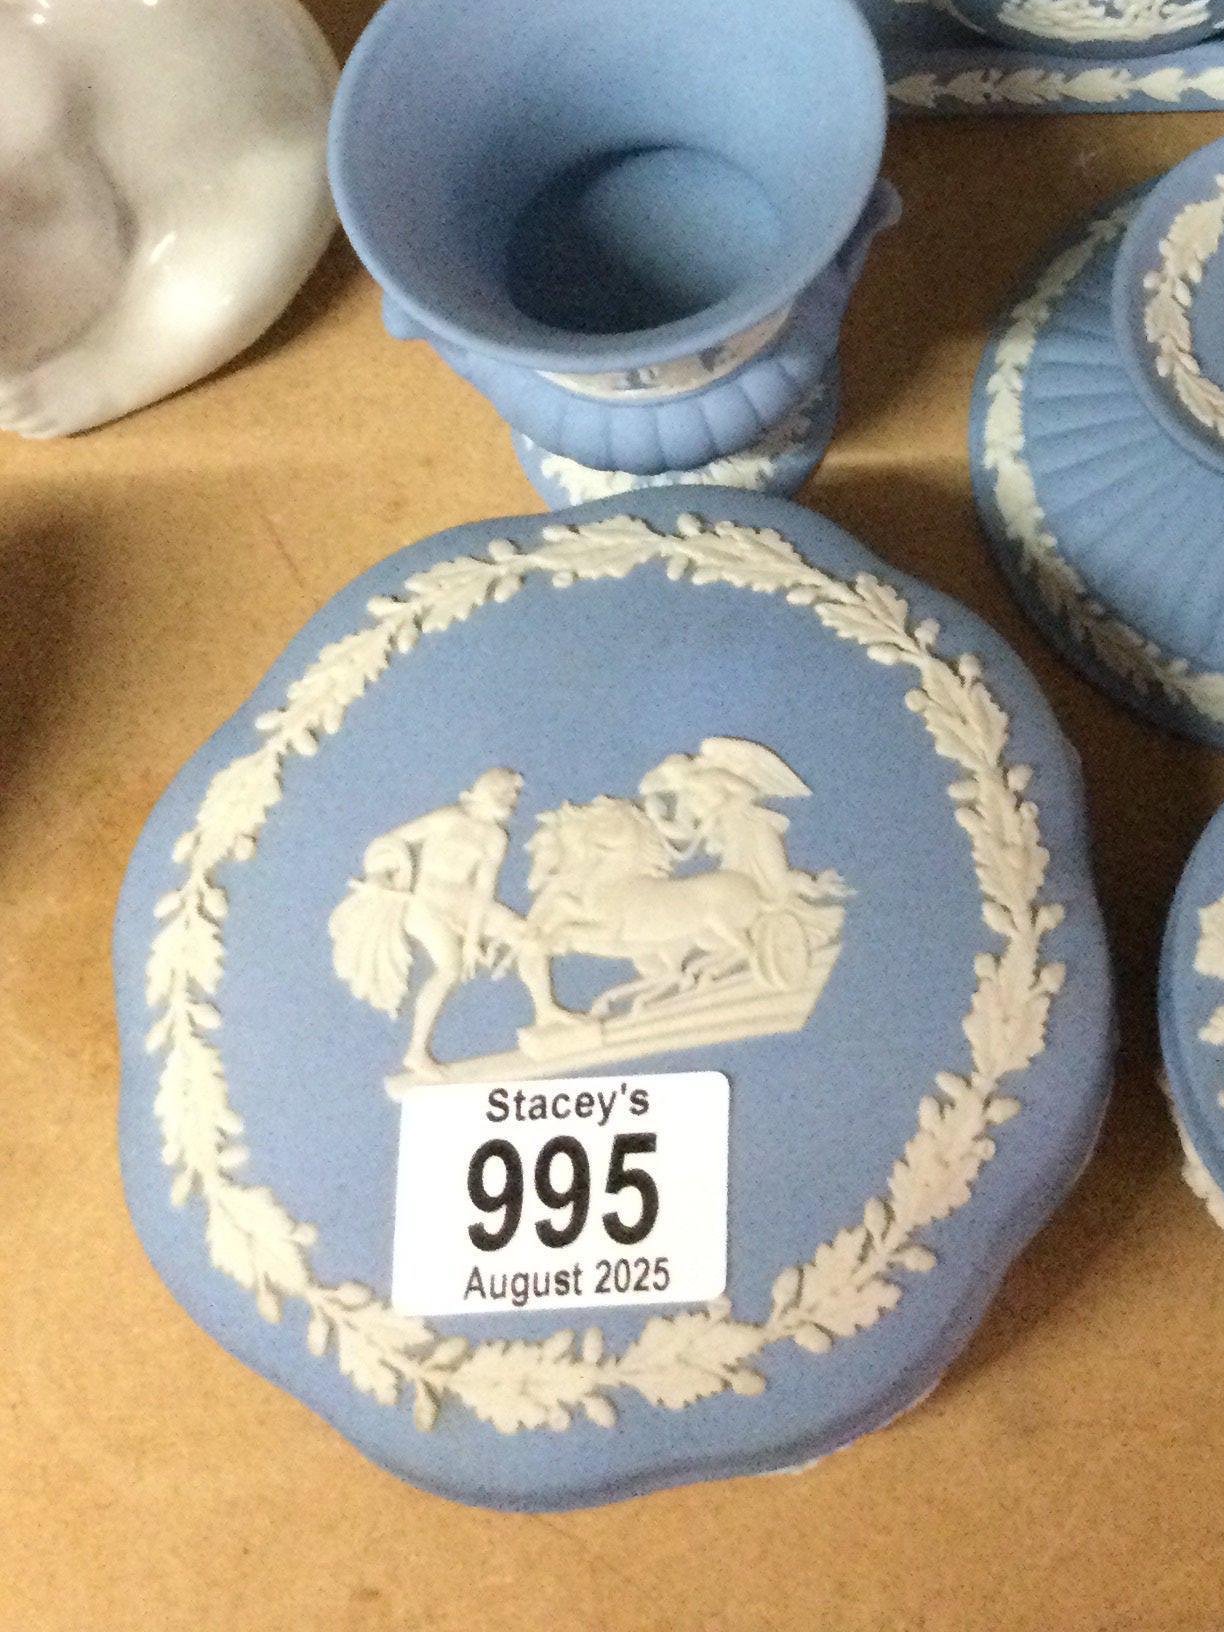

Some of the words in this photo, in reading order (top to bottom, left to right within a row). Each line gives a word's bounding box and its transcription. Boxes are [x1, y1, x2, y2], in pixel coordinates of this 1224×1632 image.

[486, 1083, 650, 1126] Stacey's
[467, 1132, 659, 1252] 995
[464, 1262, 582, 1306] August
[594, 1256, 671, 1293] 2025
